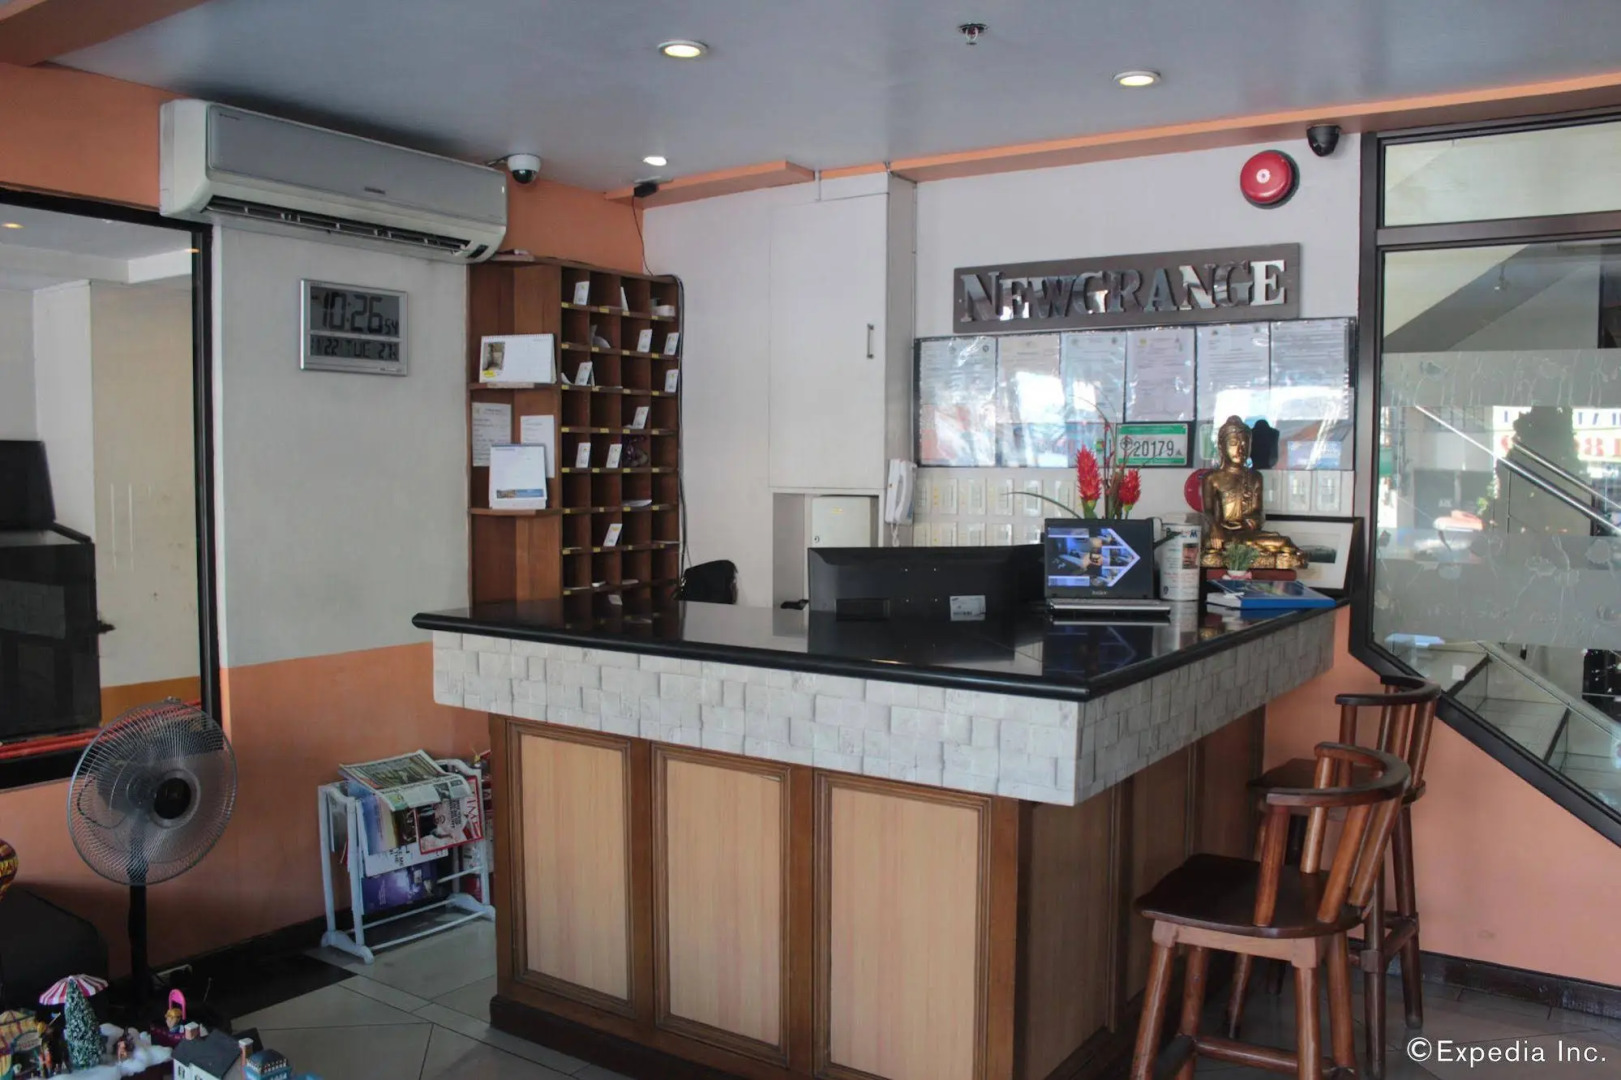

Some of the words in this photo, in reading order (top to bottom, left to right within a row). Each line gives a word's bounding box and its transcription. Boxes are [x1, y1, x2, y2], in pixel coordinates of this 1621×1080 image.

[960, 259, 1286, 322] NEWGRANGE
[322, 291, 383, 333] 10:26
[1133, 440, 1174, 457] 20179
